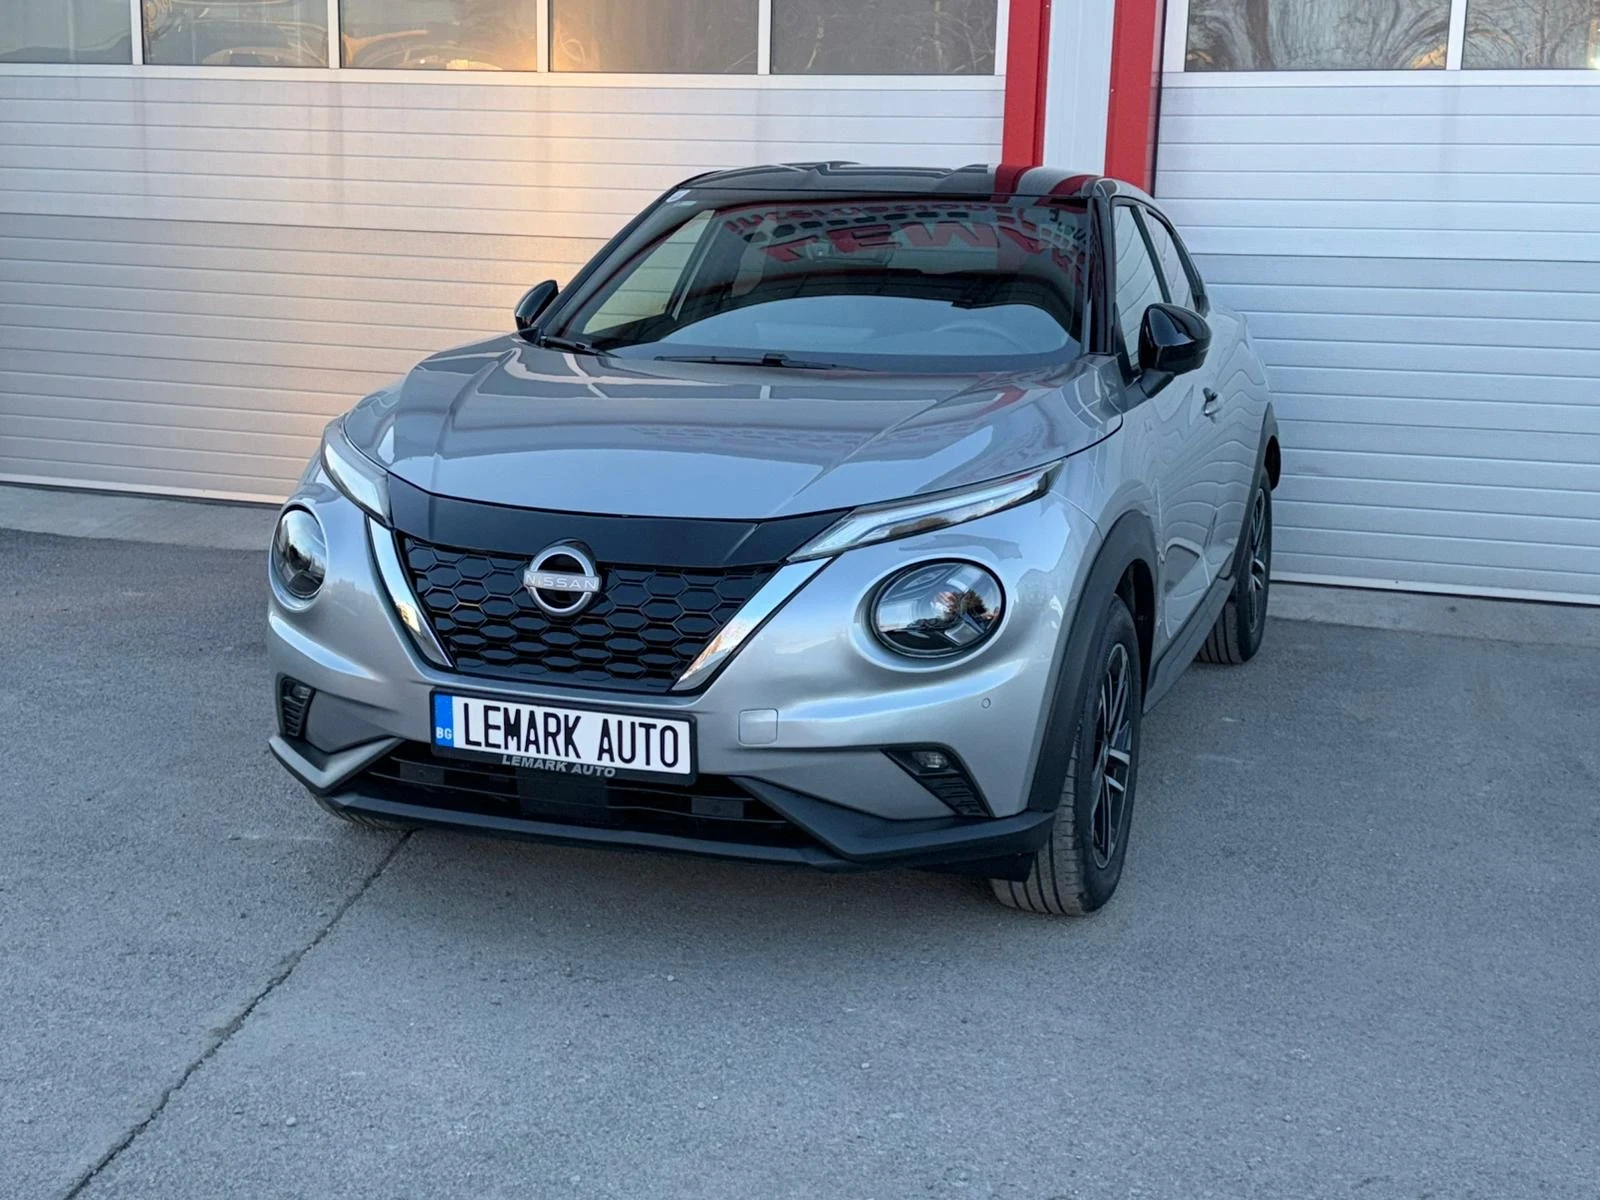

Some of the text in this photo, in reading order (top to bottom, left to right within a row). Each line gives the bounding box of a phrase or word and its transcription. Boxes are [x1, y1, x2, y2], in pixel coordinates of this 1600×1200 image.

[525, 573, 598, 591] NISSAN
[436, 725, 453, 740] BG
[463, 702, 678, 768] LEMARK AUTO
[501, 755, 616, 778] LEMARK AUTO
